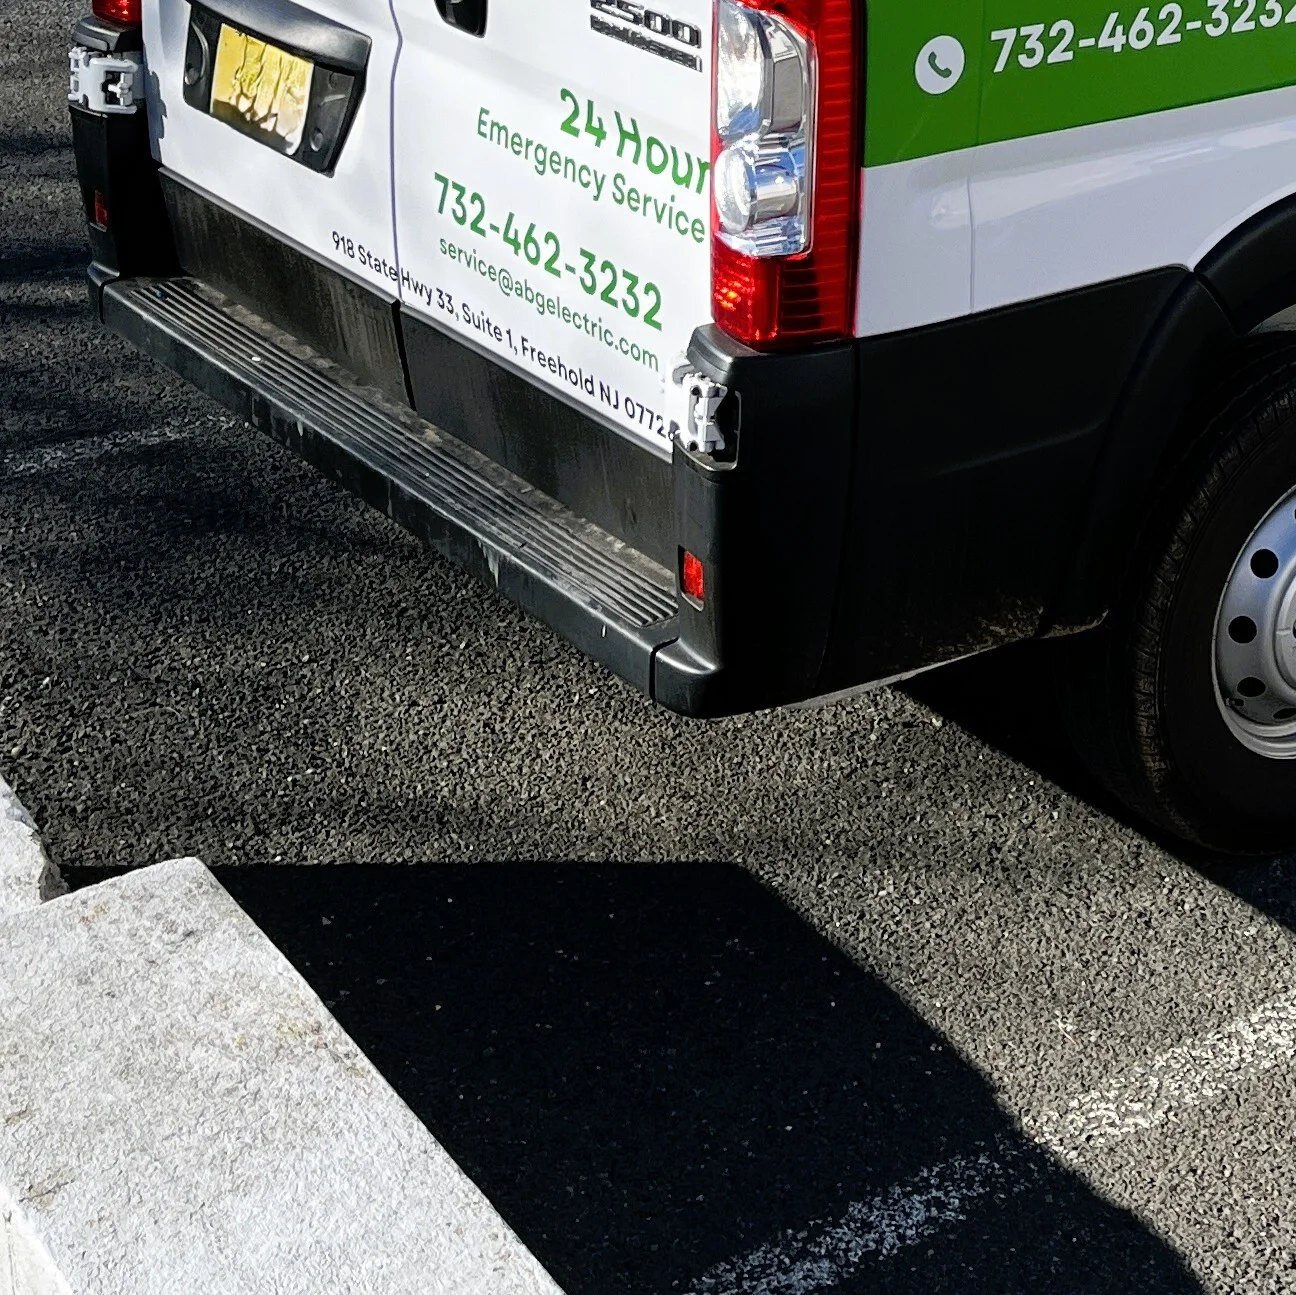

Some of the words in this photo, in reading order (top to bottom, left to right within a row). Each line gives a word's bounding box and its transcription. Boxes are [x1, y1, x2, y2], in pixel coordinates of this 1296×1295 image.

[477, 107, 606, 201] Emergency
[612, 173, 706, 244] Service
[560, 88, 607, 148] 24
[614, 110, 710, 195] Hour
[434, 172, 663, 331] 732-462-3232
[439, 237, 659, 372] service@abgelectric.com
[332, 231, 355, 259] 918
[358, 244, 398, 282] State
[401, 267, 432, 306] Hwy
[436, 287, 460, 321] 33,
[462, 302, 502, 342] Suite
[506, 328, 518, 356] 1,
[521, 337, 595, 397] Freehold
[599, 380, 619, 410] NJ
